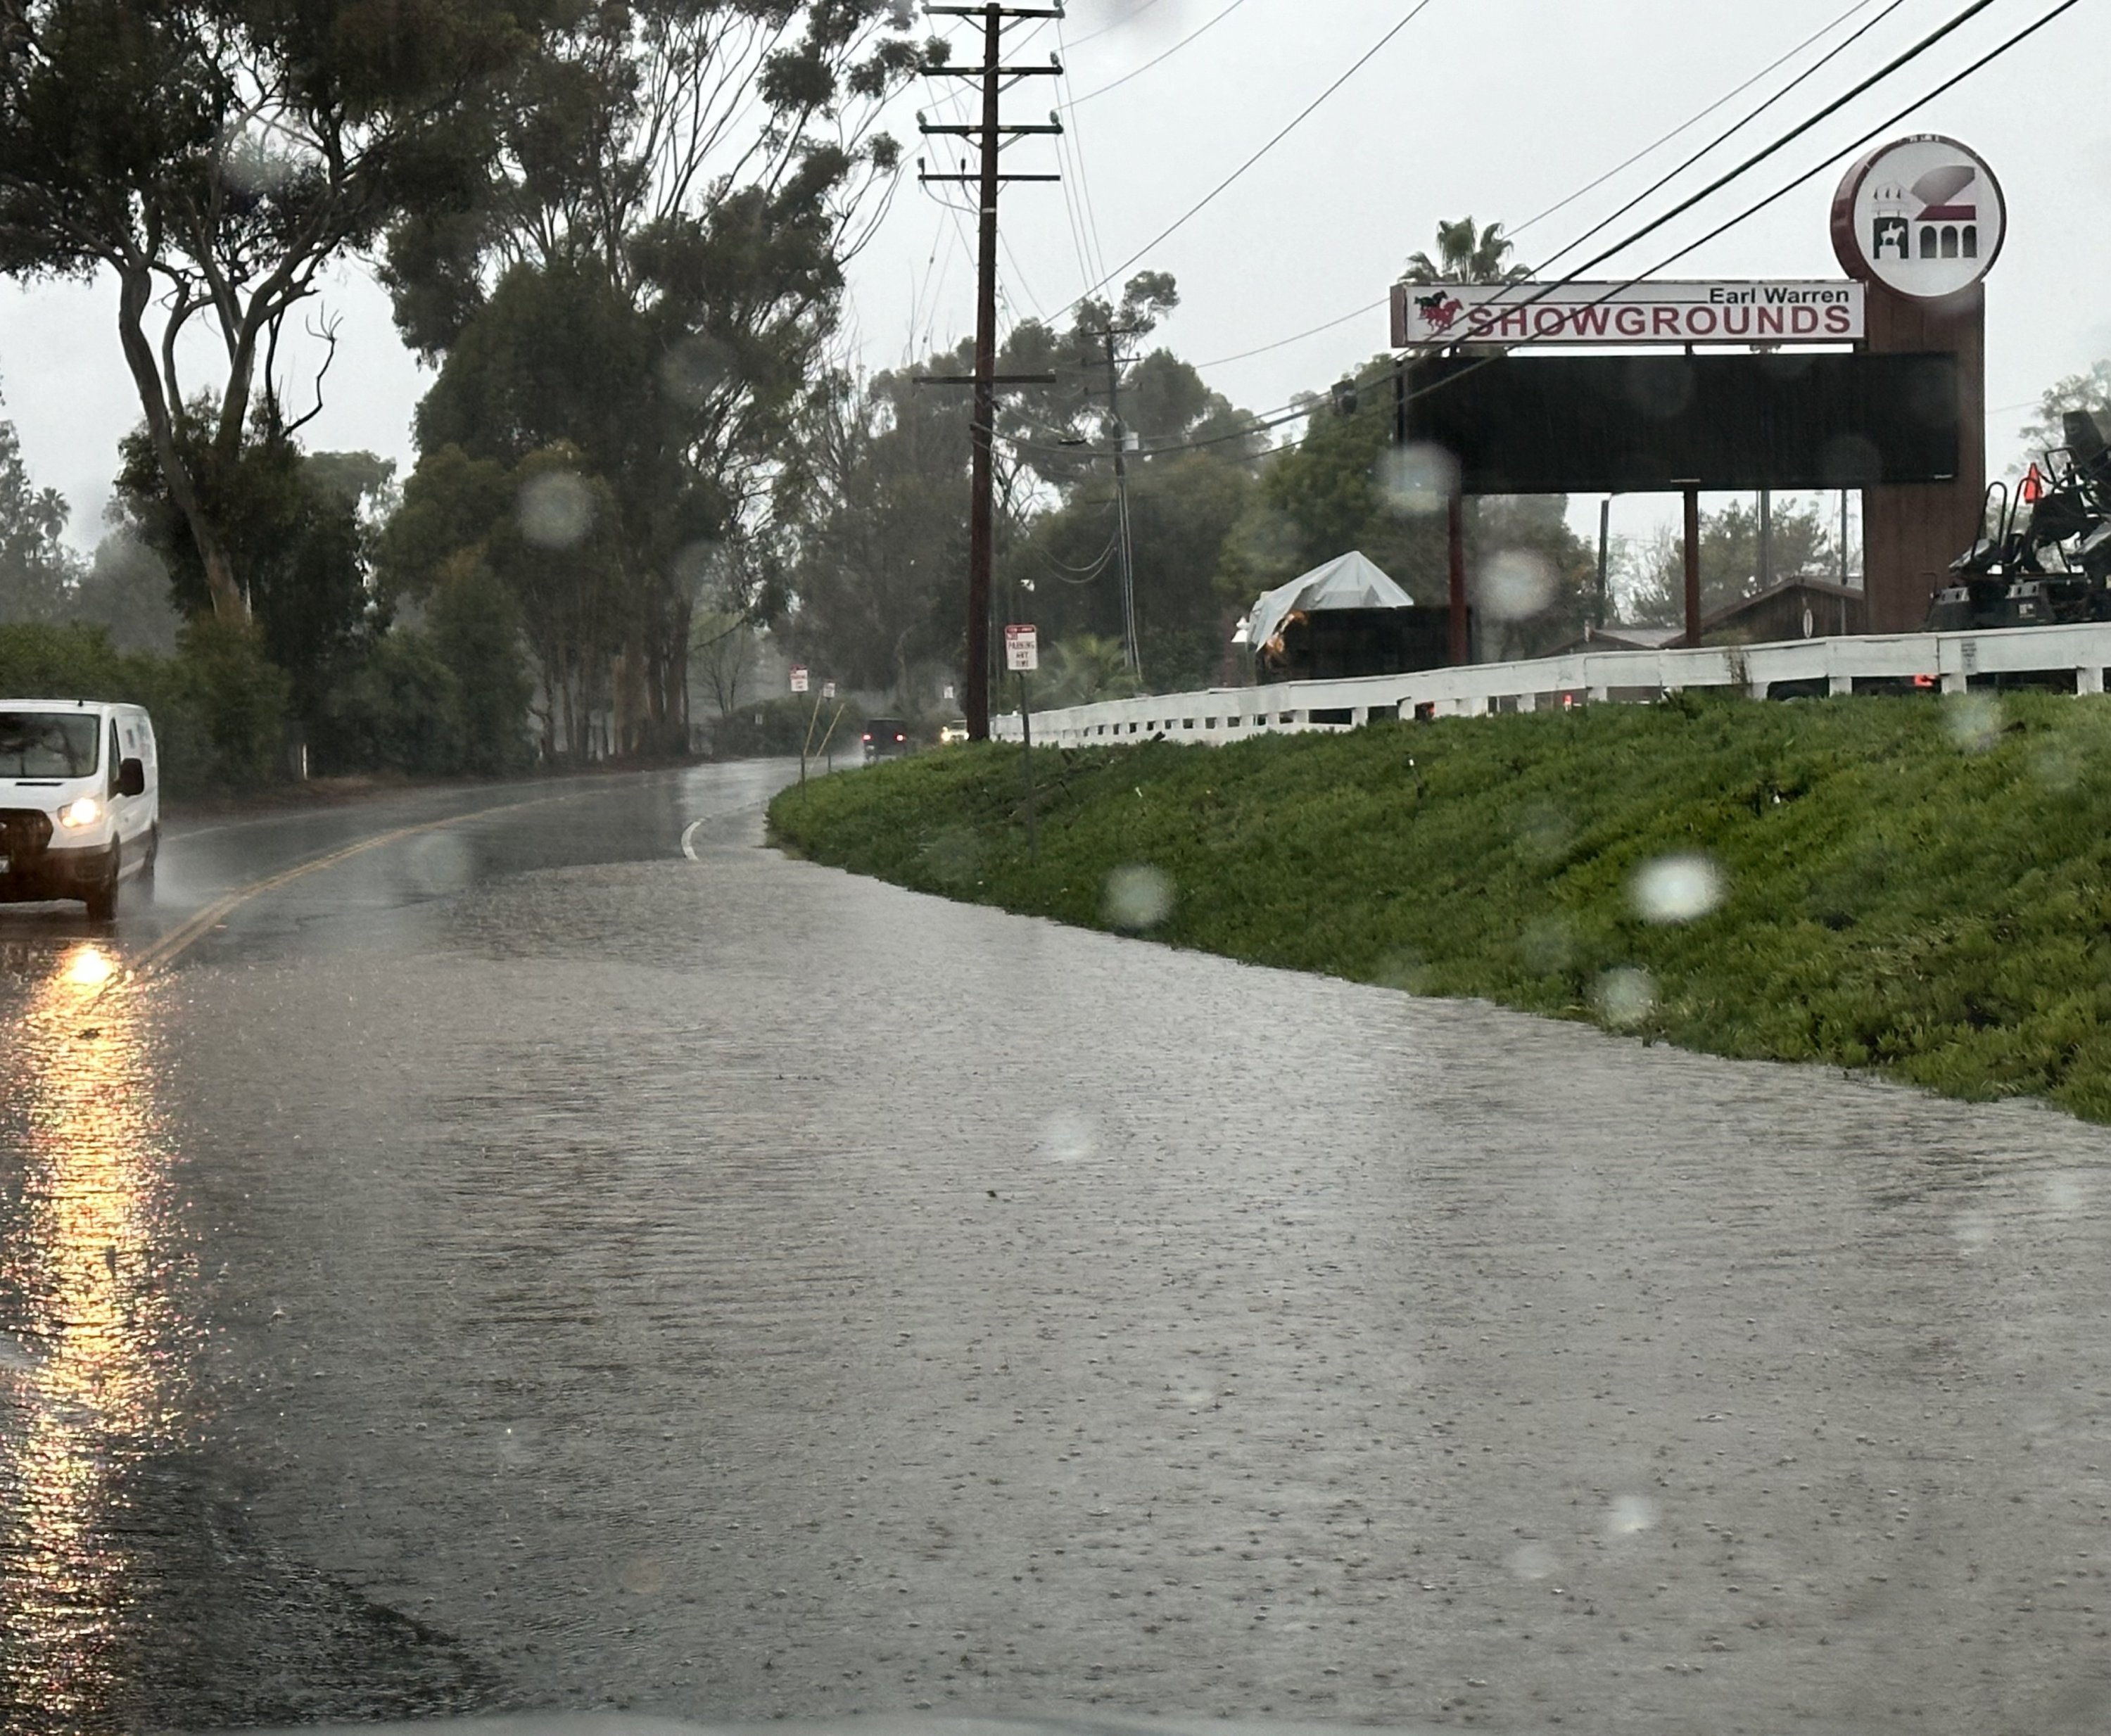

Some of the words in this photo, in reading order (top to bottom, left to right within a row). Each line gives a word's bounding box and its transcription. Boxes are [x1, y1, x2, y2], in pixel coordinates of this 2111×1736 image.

[1710, 287, 1755, 304] Earl
[1764, 287, 1850, 304] Warren
[1469, 305, 1851, 336] SHOWGROUNDS
